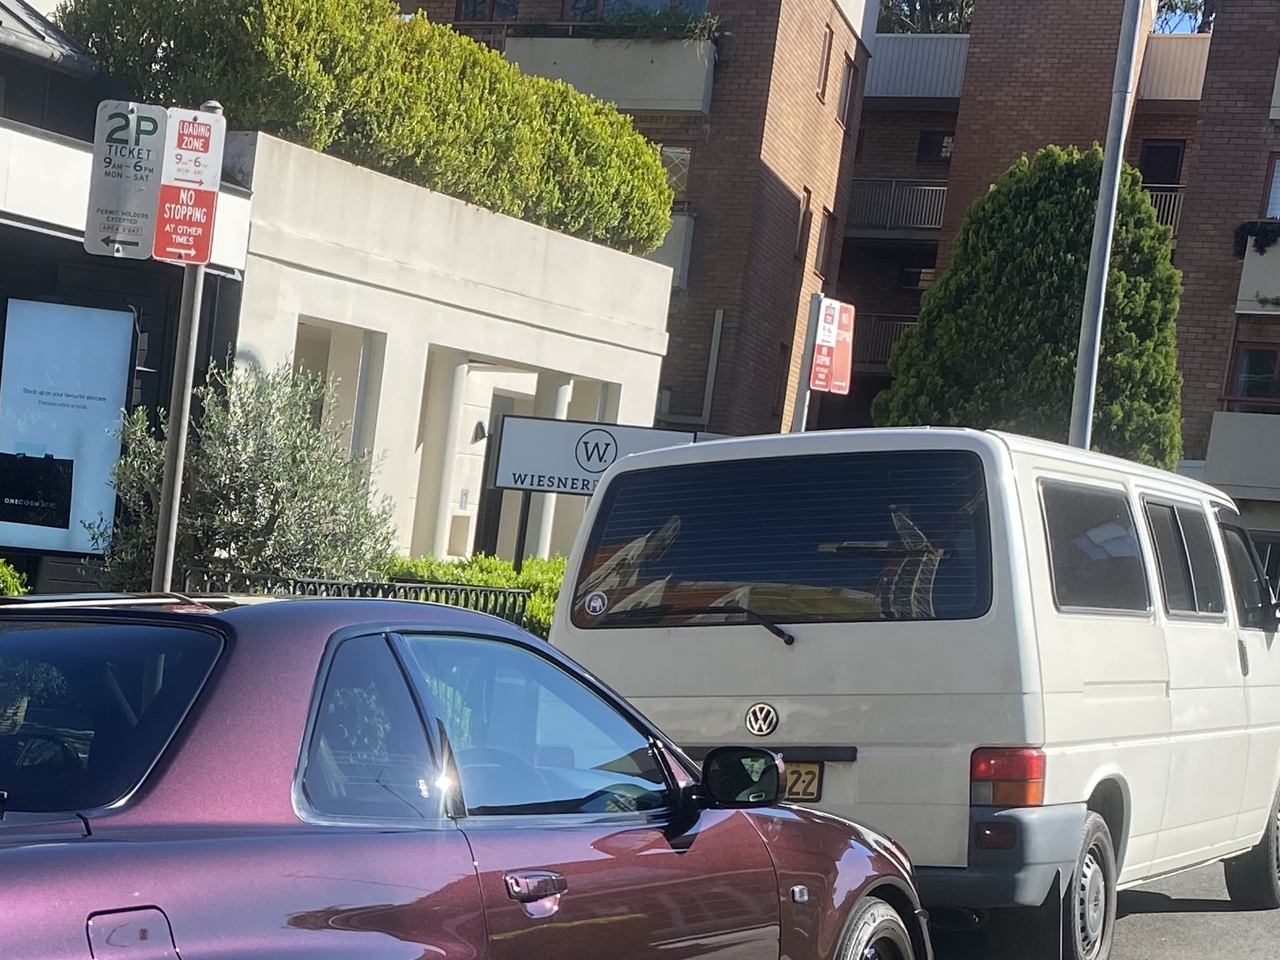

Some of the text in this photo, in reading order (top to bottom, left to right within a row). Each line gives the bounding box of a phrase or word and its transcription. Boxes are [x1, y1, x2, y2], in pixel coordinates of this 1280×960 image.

[105, 112, 159, 146] 2P
[179, 120, 210, 137] LOADING
[181, 136, 205, 151] ZONE
[107, 144, 152, 161] TICKET
[104, 170, 122, 179] MON
[133, 173, 150, 182] SAT
[180, 188, 195, 206] NO
[96, 208, 149, 220] PERMIT HOLDERS
[163, 203, 208, 223] STOPPING
[106, 216, 138, 225] EXCEPTED
[102, 224, 120, 232] AREA
[164, 223, 203, 236] AT OTHER
[171, 234, 194, 245] TIMES
